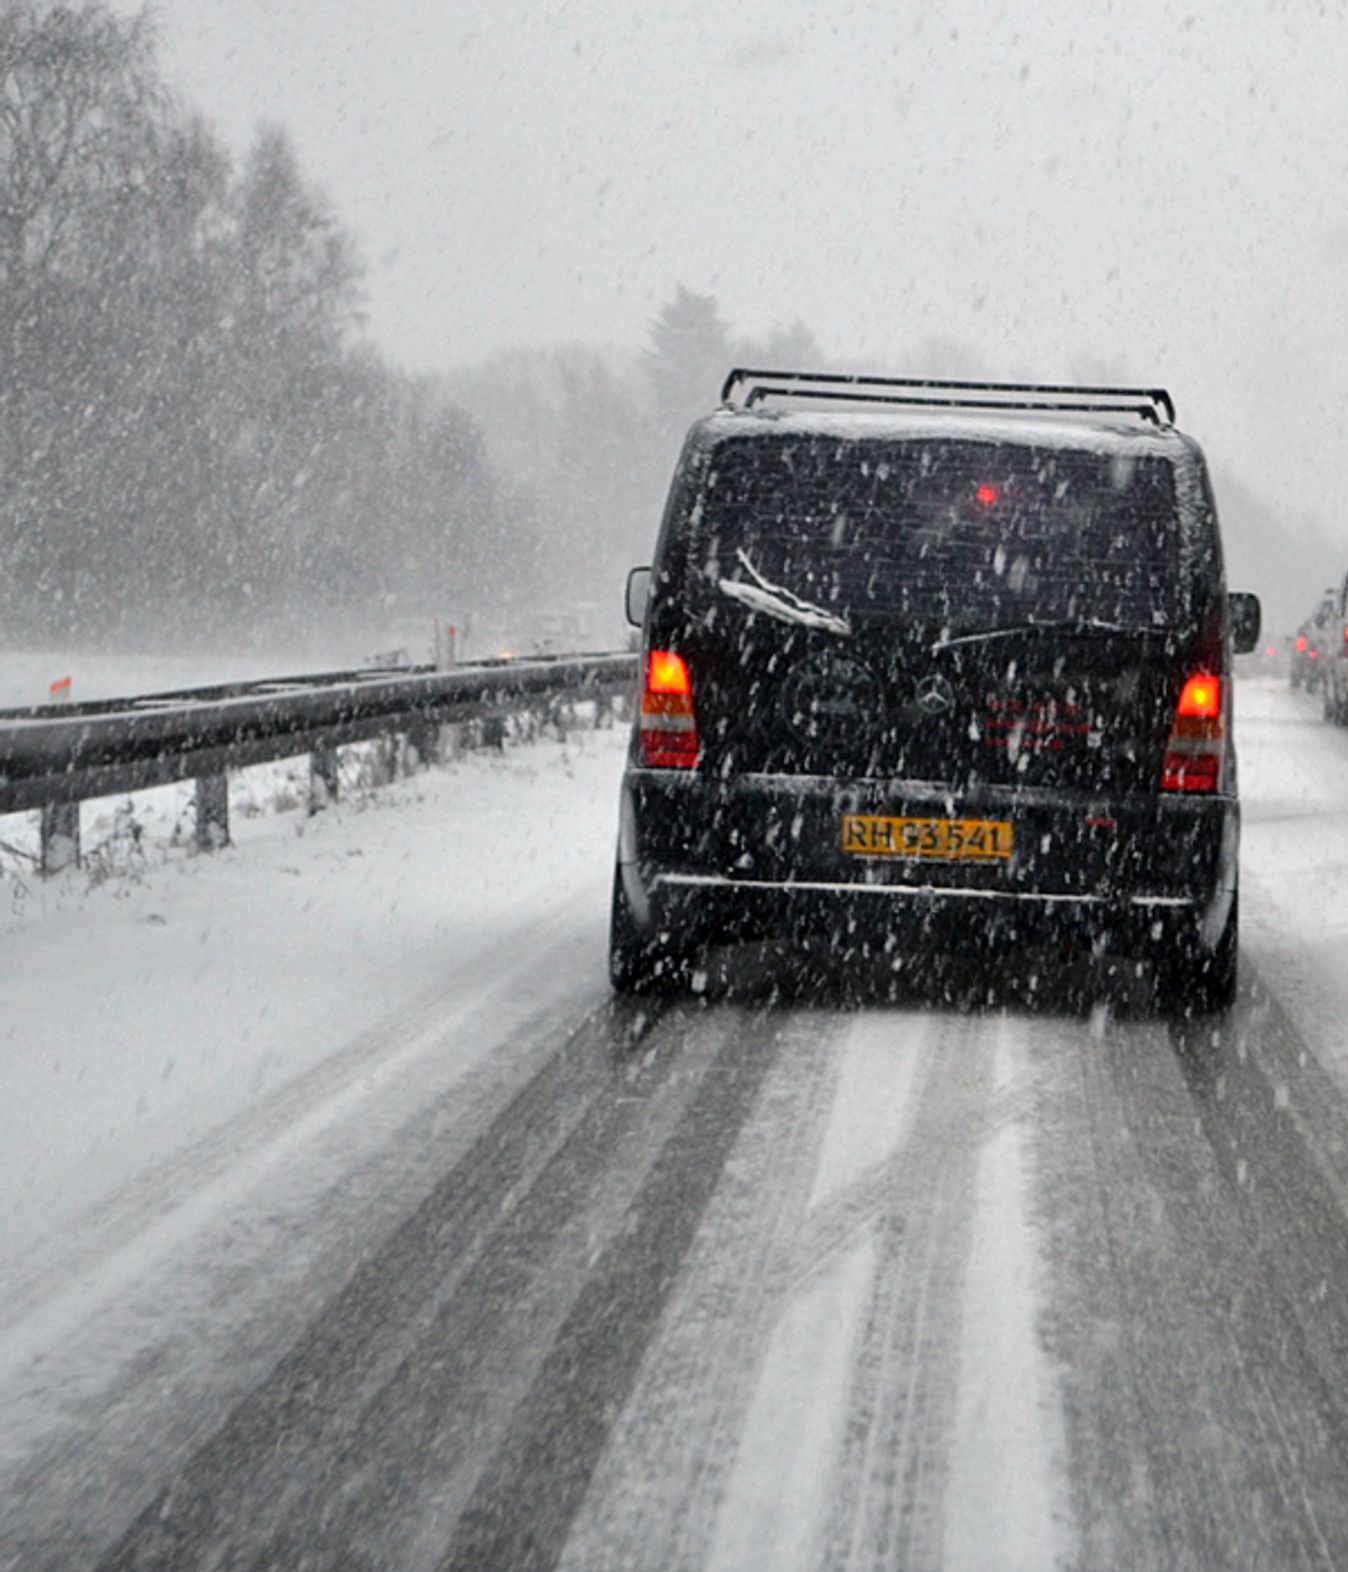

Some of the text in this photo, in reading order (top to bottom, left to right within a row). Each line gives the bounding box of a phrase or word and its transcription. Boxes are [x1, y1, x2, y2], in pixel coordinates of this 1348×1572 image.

[848, 821, 998, 852] RH 93 541
